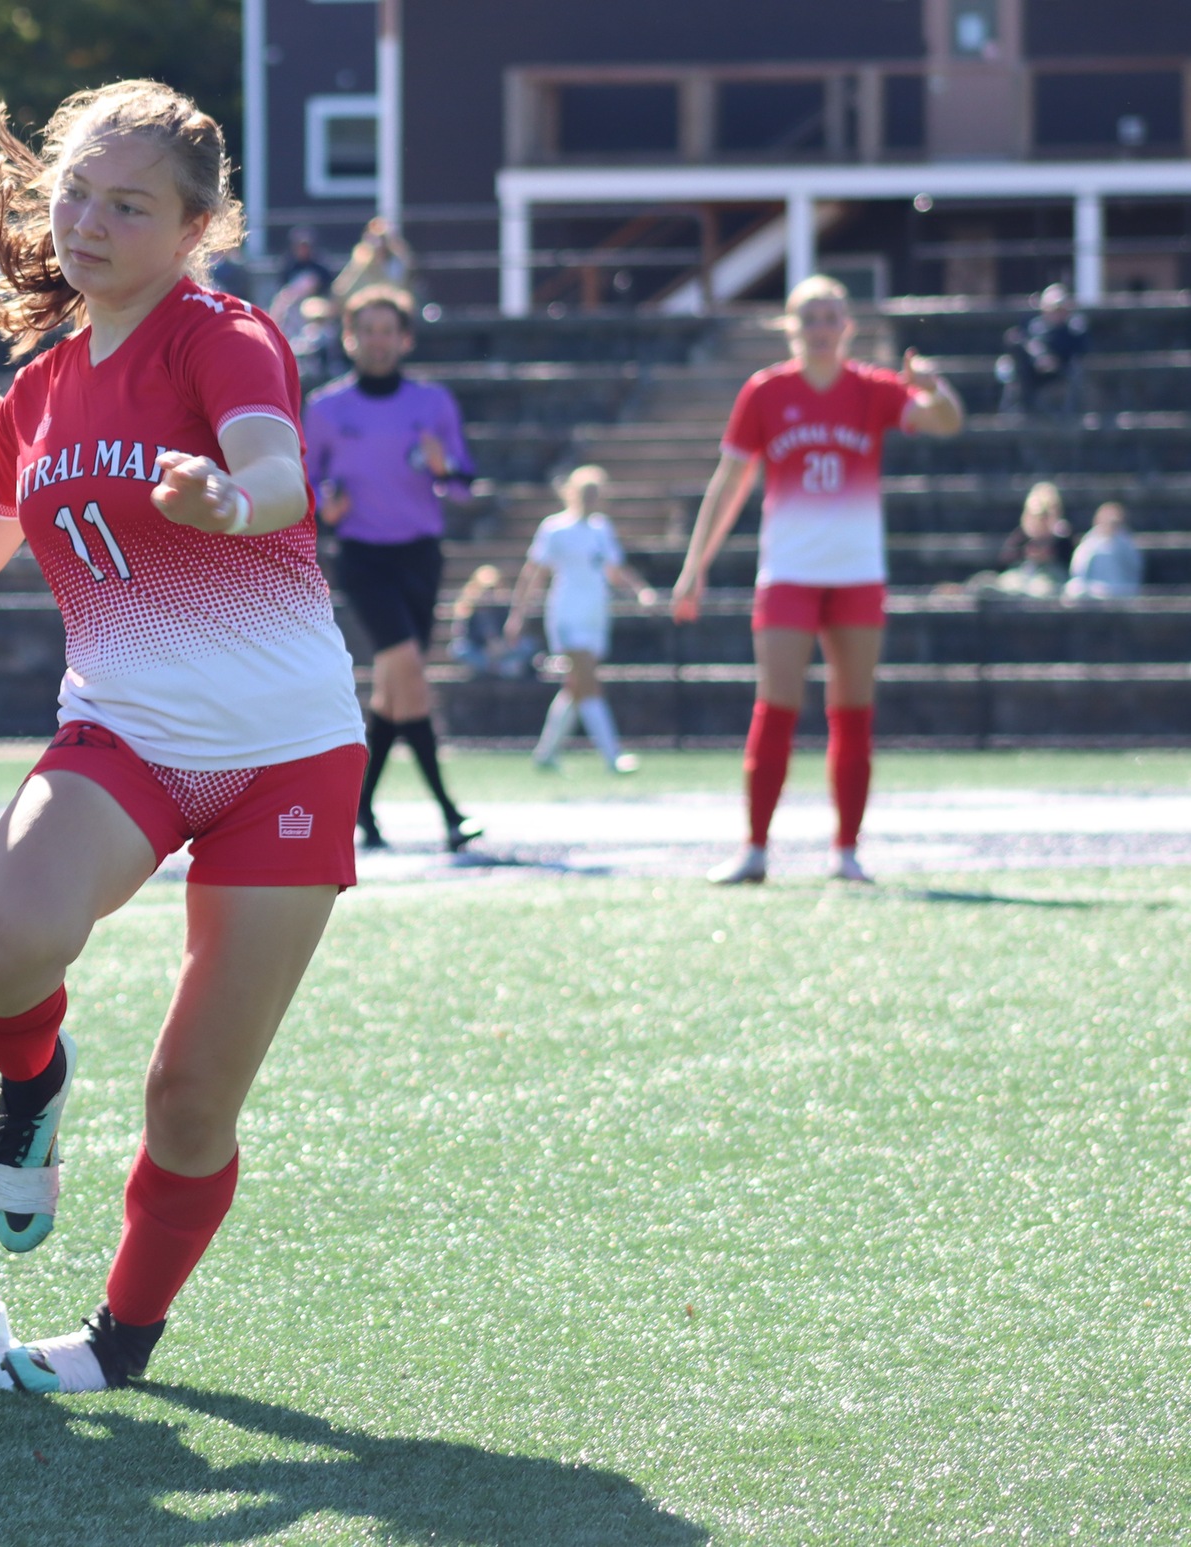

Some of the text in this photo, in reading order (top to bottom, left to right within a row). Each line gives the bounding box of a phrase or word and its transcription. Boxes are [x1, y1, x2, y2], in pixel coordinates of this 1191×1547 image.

[91, 439, 188, 484] MAI
[803, 452, 841, 493] 20
[54, 501, 132, 582] 11
